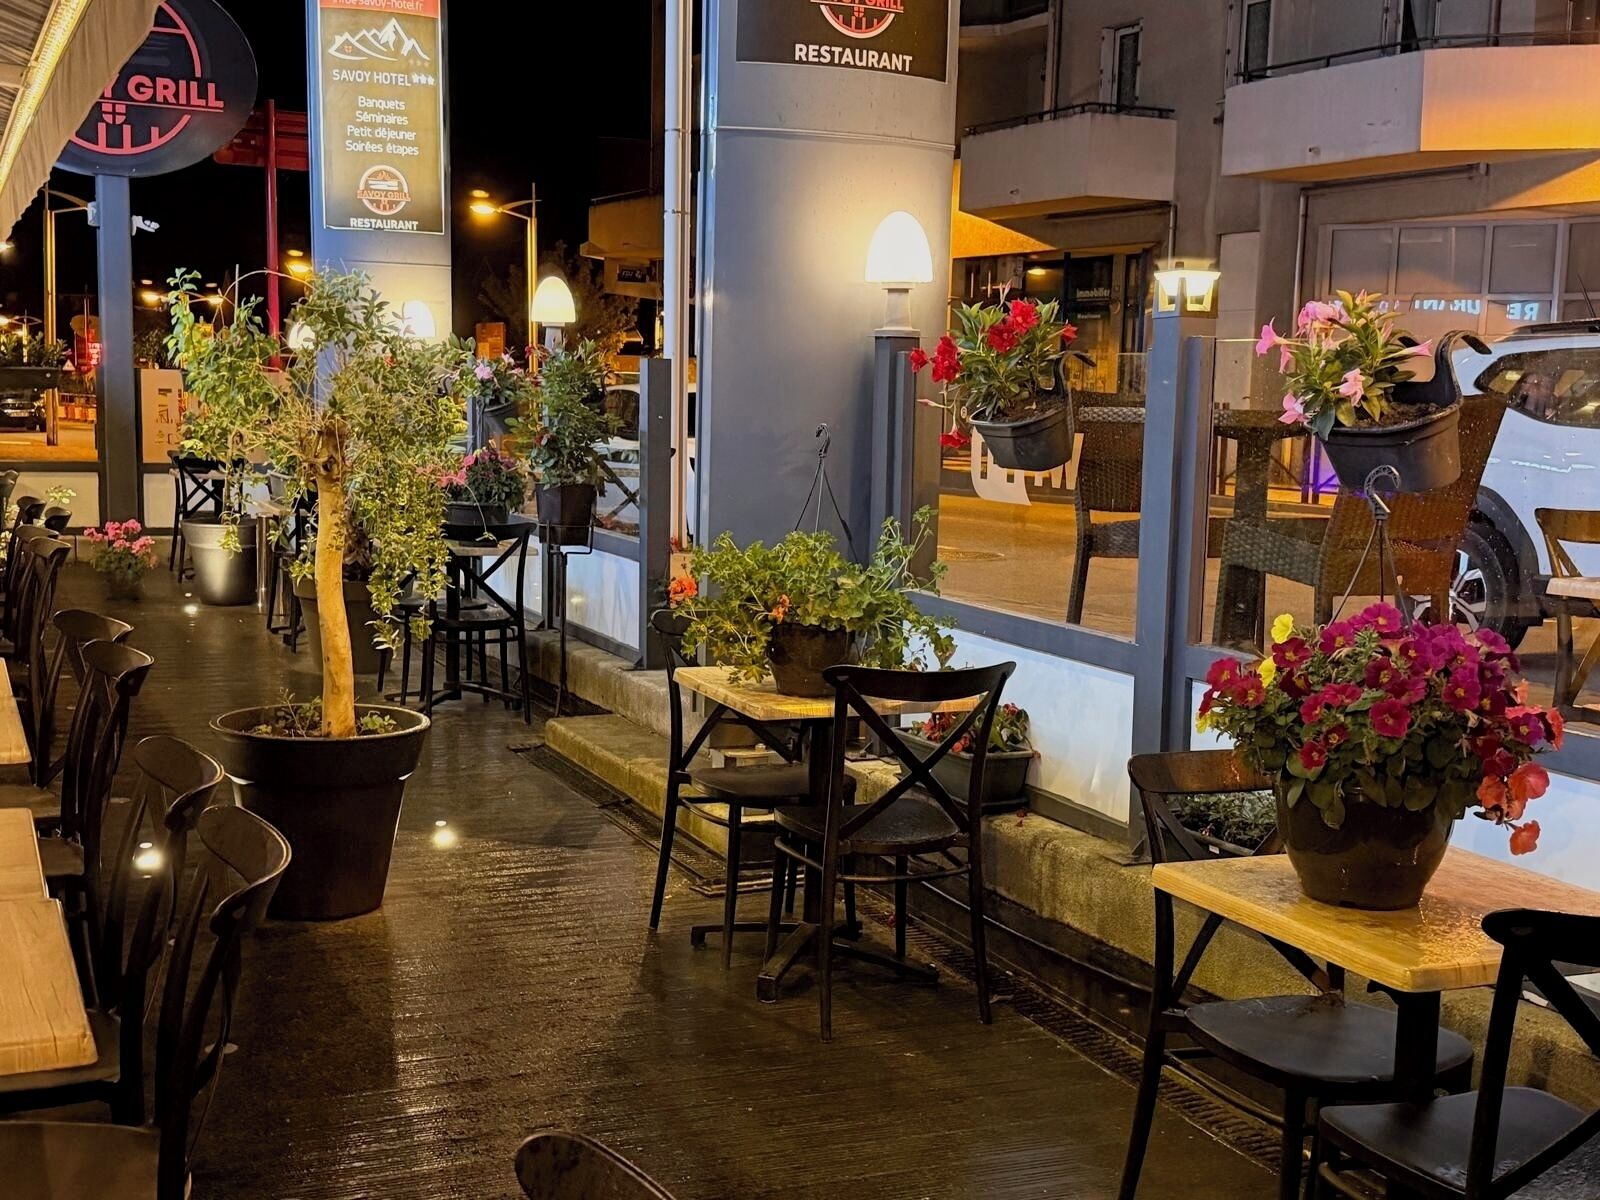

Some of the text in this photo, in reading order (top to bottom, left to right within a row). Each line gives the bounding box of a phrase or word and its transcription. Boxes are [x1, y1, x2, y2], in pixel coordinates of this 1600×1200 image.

[794, 43, 913, 72] RESTAURANT
[332, 69, 411, 86] SAVOY HOTEL
[127, 75, 225, 108] GRILL
[358, 95, 406, 110] Banquets
[356, 110, 408, 125] Séminaires
[347, 125, 416, 141] Petit déjeuner
[345, 140, 419, 156] Soirées étapes
[357, 190, 386, 199] SAVOY
[350, 218, 418, 230] RESTAURANT
